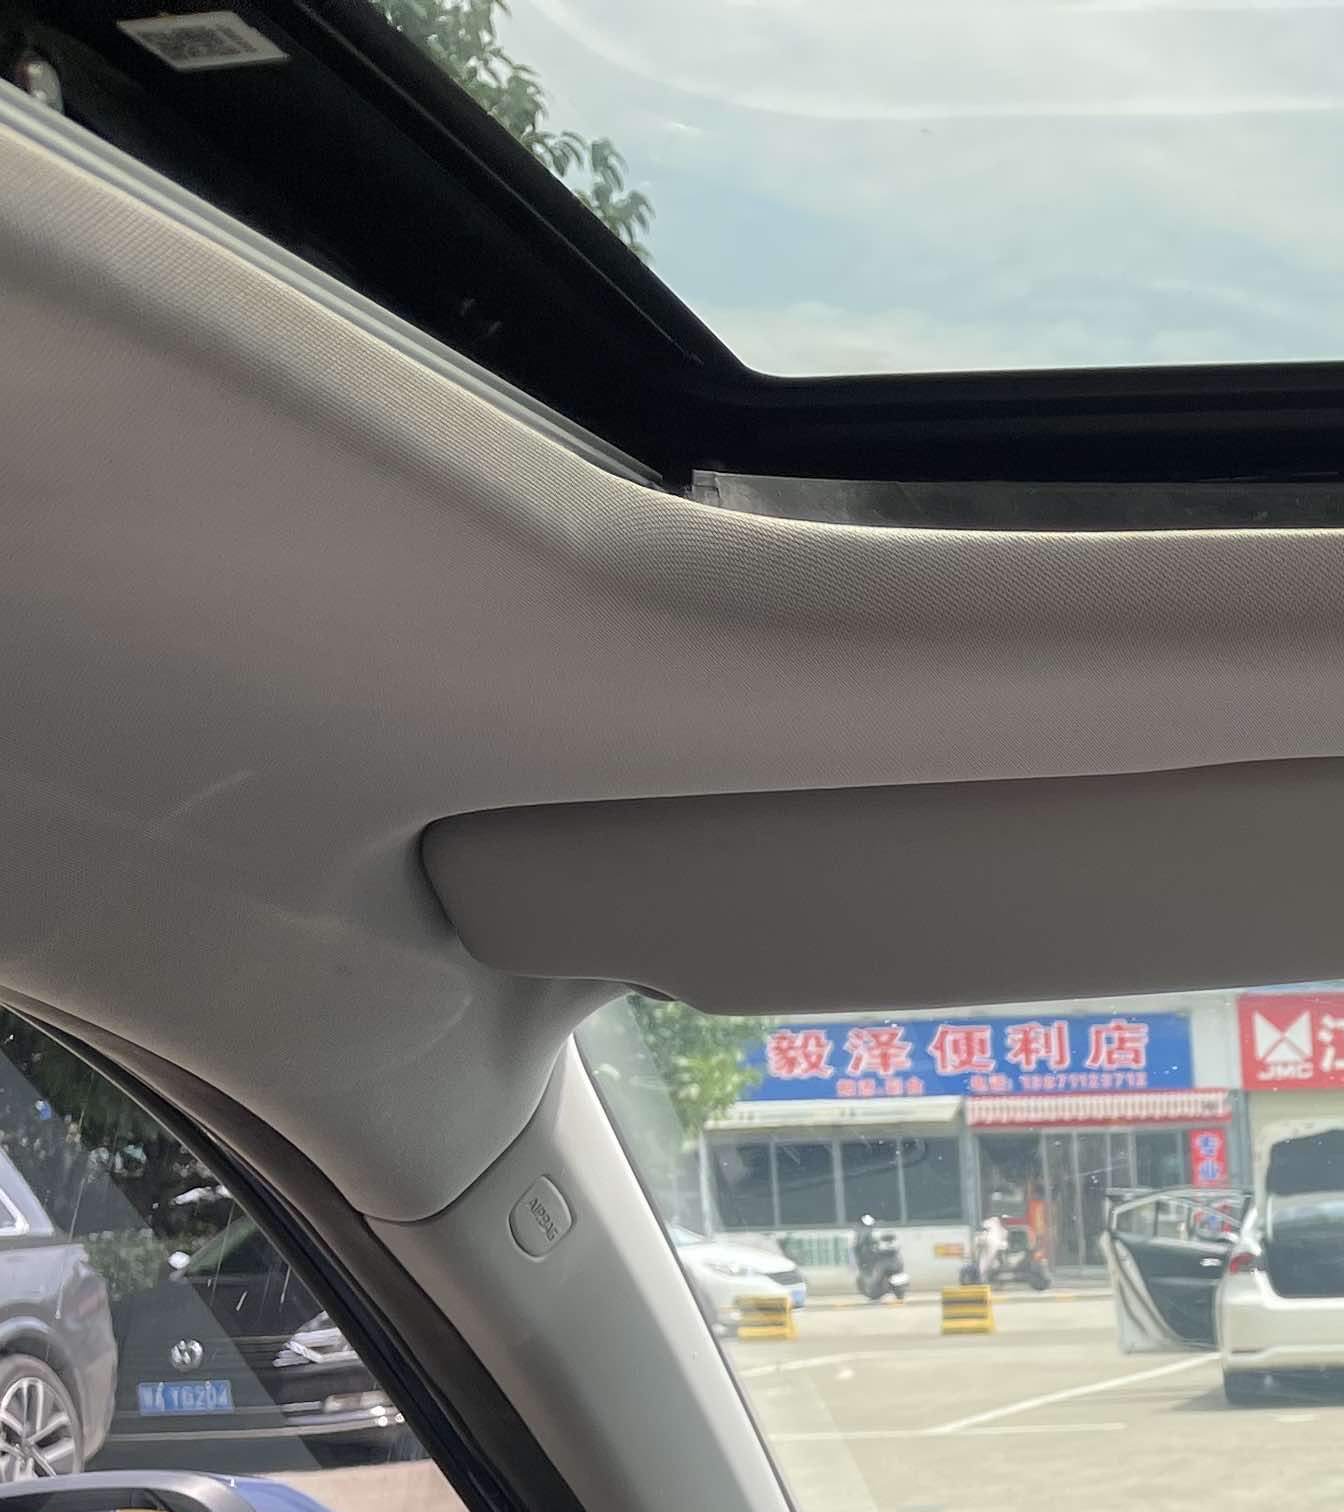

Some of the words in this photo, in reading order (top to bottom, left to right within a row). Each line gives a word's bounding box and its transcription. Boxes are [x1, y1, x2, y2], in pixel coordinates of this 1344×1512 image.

[766, 1020, 1149, 1079] 毅泽便利店
[1256, 1062, 1313, 1080] JMC
[527, 1197, 559, 1242] AIRBAG
